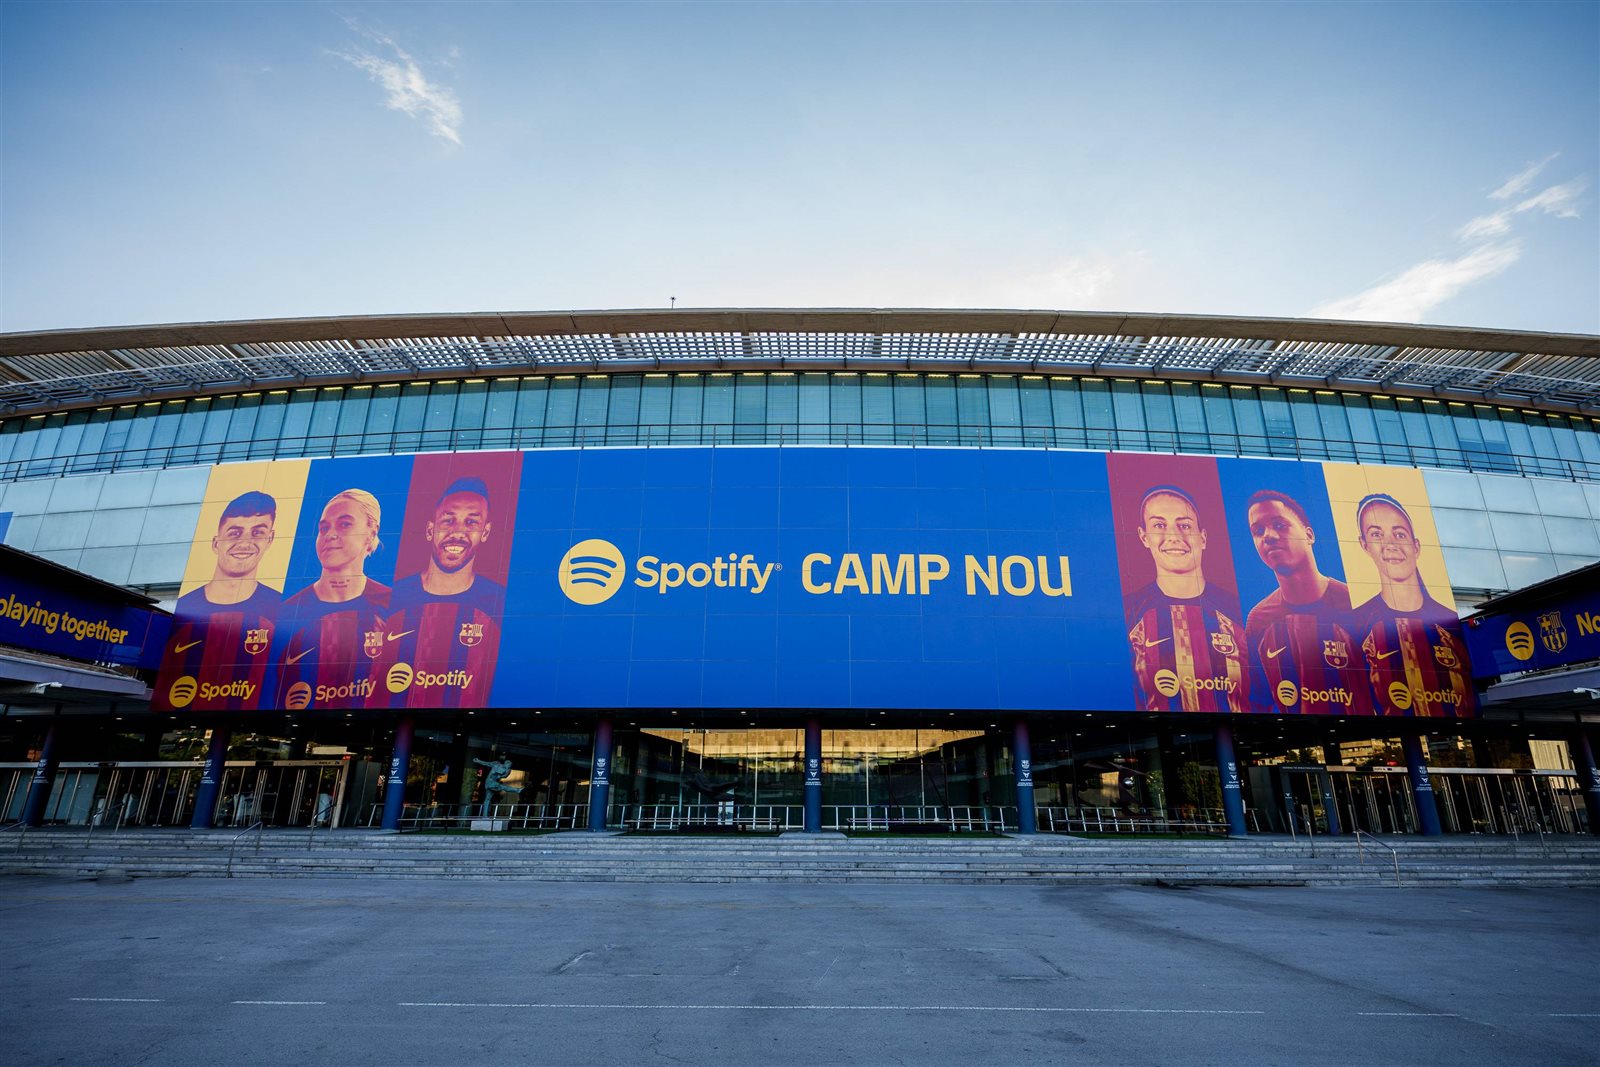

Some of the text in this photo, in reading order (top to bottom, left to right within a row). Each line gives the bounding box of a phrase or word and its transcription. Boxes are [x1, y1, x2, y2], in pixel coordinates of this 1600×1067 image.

[801, 552, 951, 595] CAMP
[965, 555, 1073, 597] NOU
[61, 612, 128, 644] together
[415, 669, 473, 688] Spotify
[1183, 676, 1237, 693] Spotify
[200, 680, 256, 700] Spotify
[315, 678, 376, 702] Spotify
[1300, 687, 1353, 706] Spotify
[1414, 688, 1462, 707] Spotify
